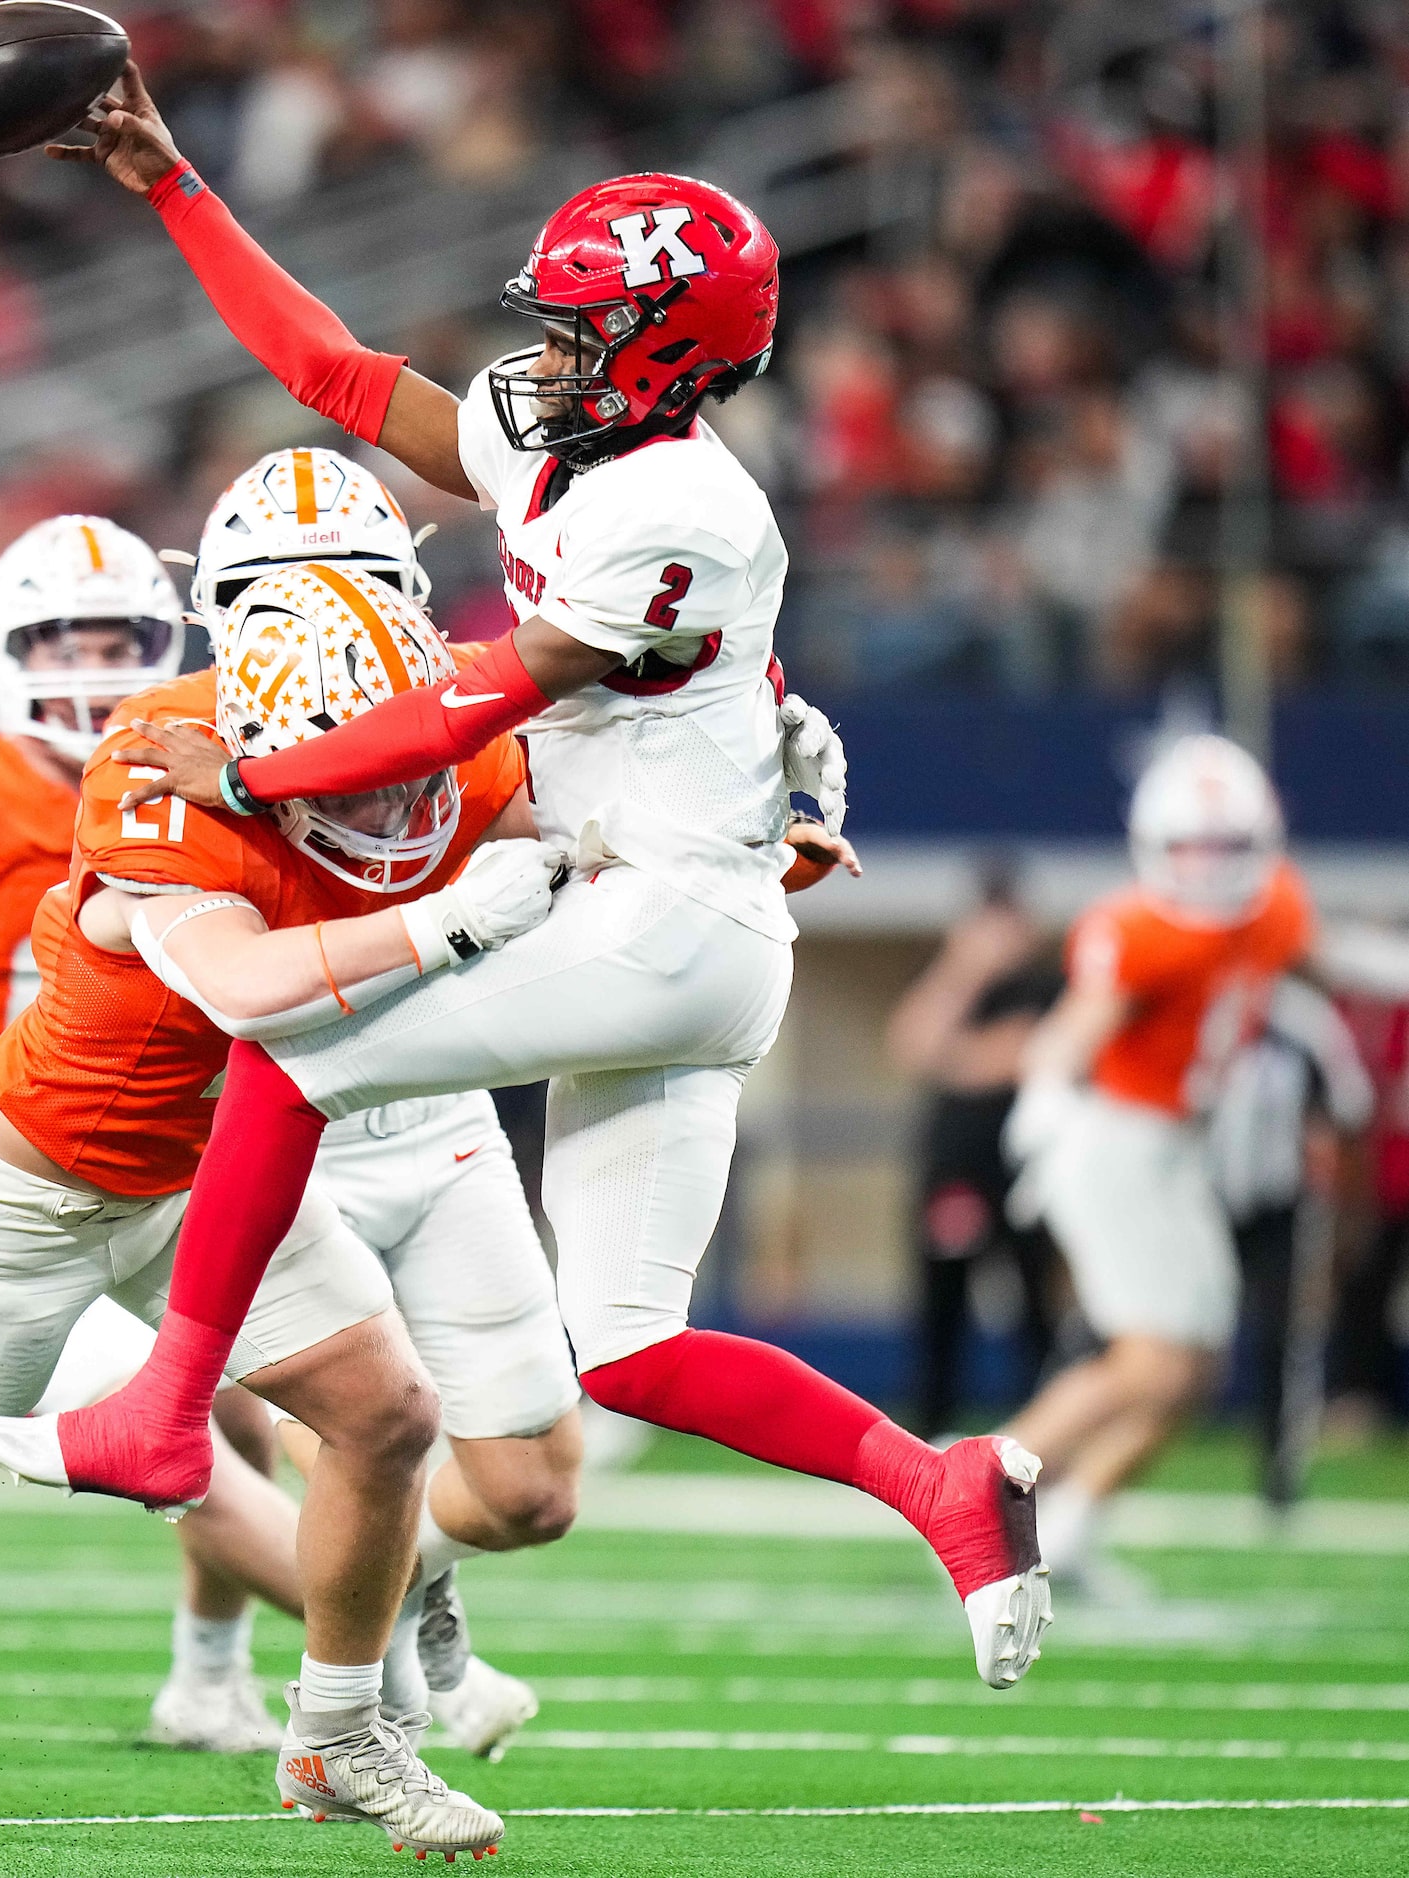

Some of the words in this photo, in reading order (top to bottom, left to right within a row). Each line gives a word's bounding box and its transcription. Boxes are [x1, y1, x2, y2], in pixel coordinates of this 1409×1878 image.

[608, 206, 708, 291] K
[643, 562, 694, 632] 2
[120, 766, 187, 843] 21
[285, 1758, 336, 1797] adidas
